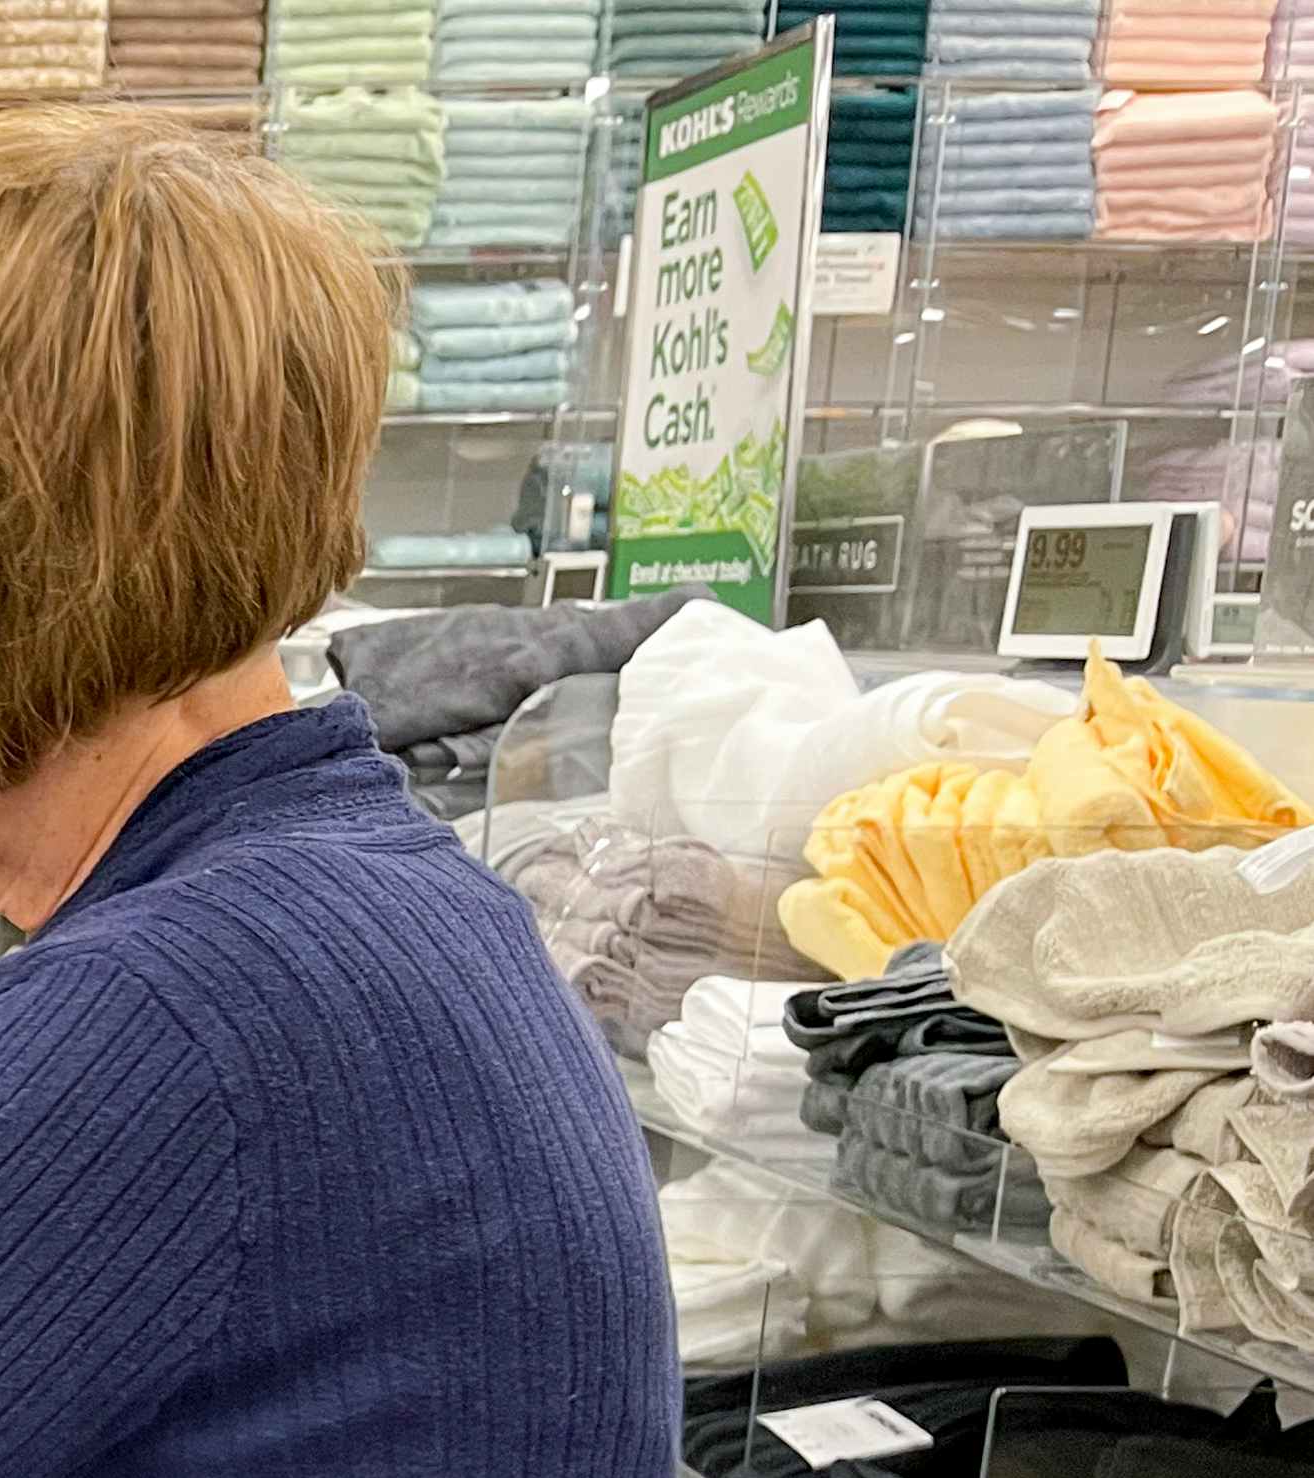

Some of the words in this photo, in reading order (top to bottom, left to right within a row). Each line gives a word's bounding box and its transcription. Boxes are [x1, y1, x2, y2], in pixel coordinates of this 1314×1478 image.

[658, 96, 735, 159] KOHL'S
[661, 189, 718, 250] Earn
[656, 246, 723, 307] more
[650, 308, 729, 380] Kohl's
[838, 539, 878, 570] RUG
[1030, 530, 1087, 569] 9.99
